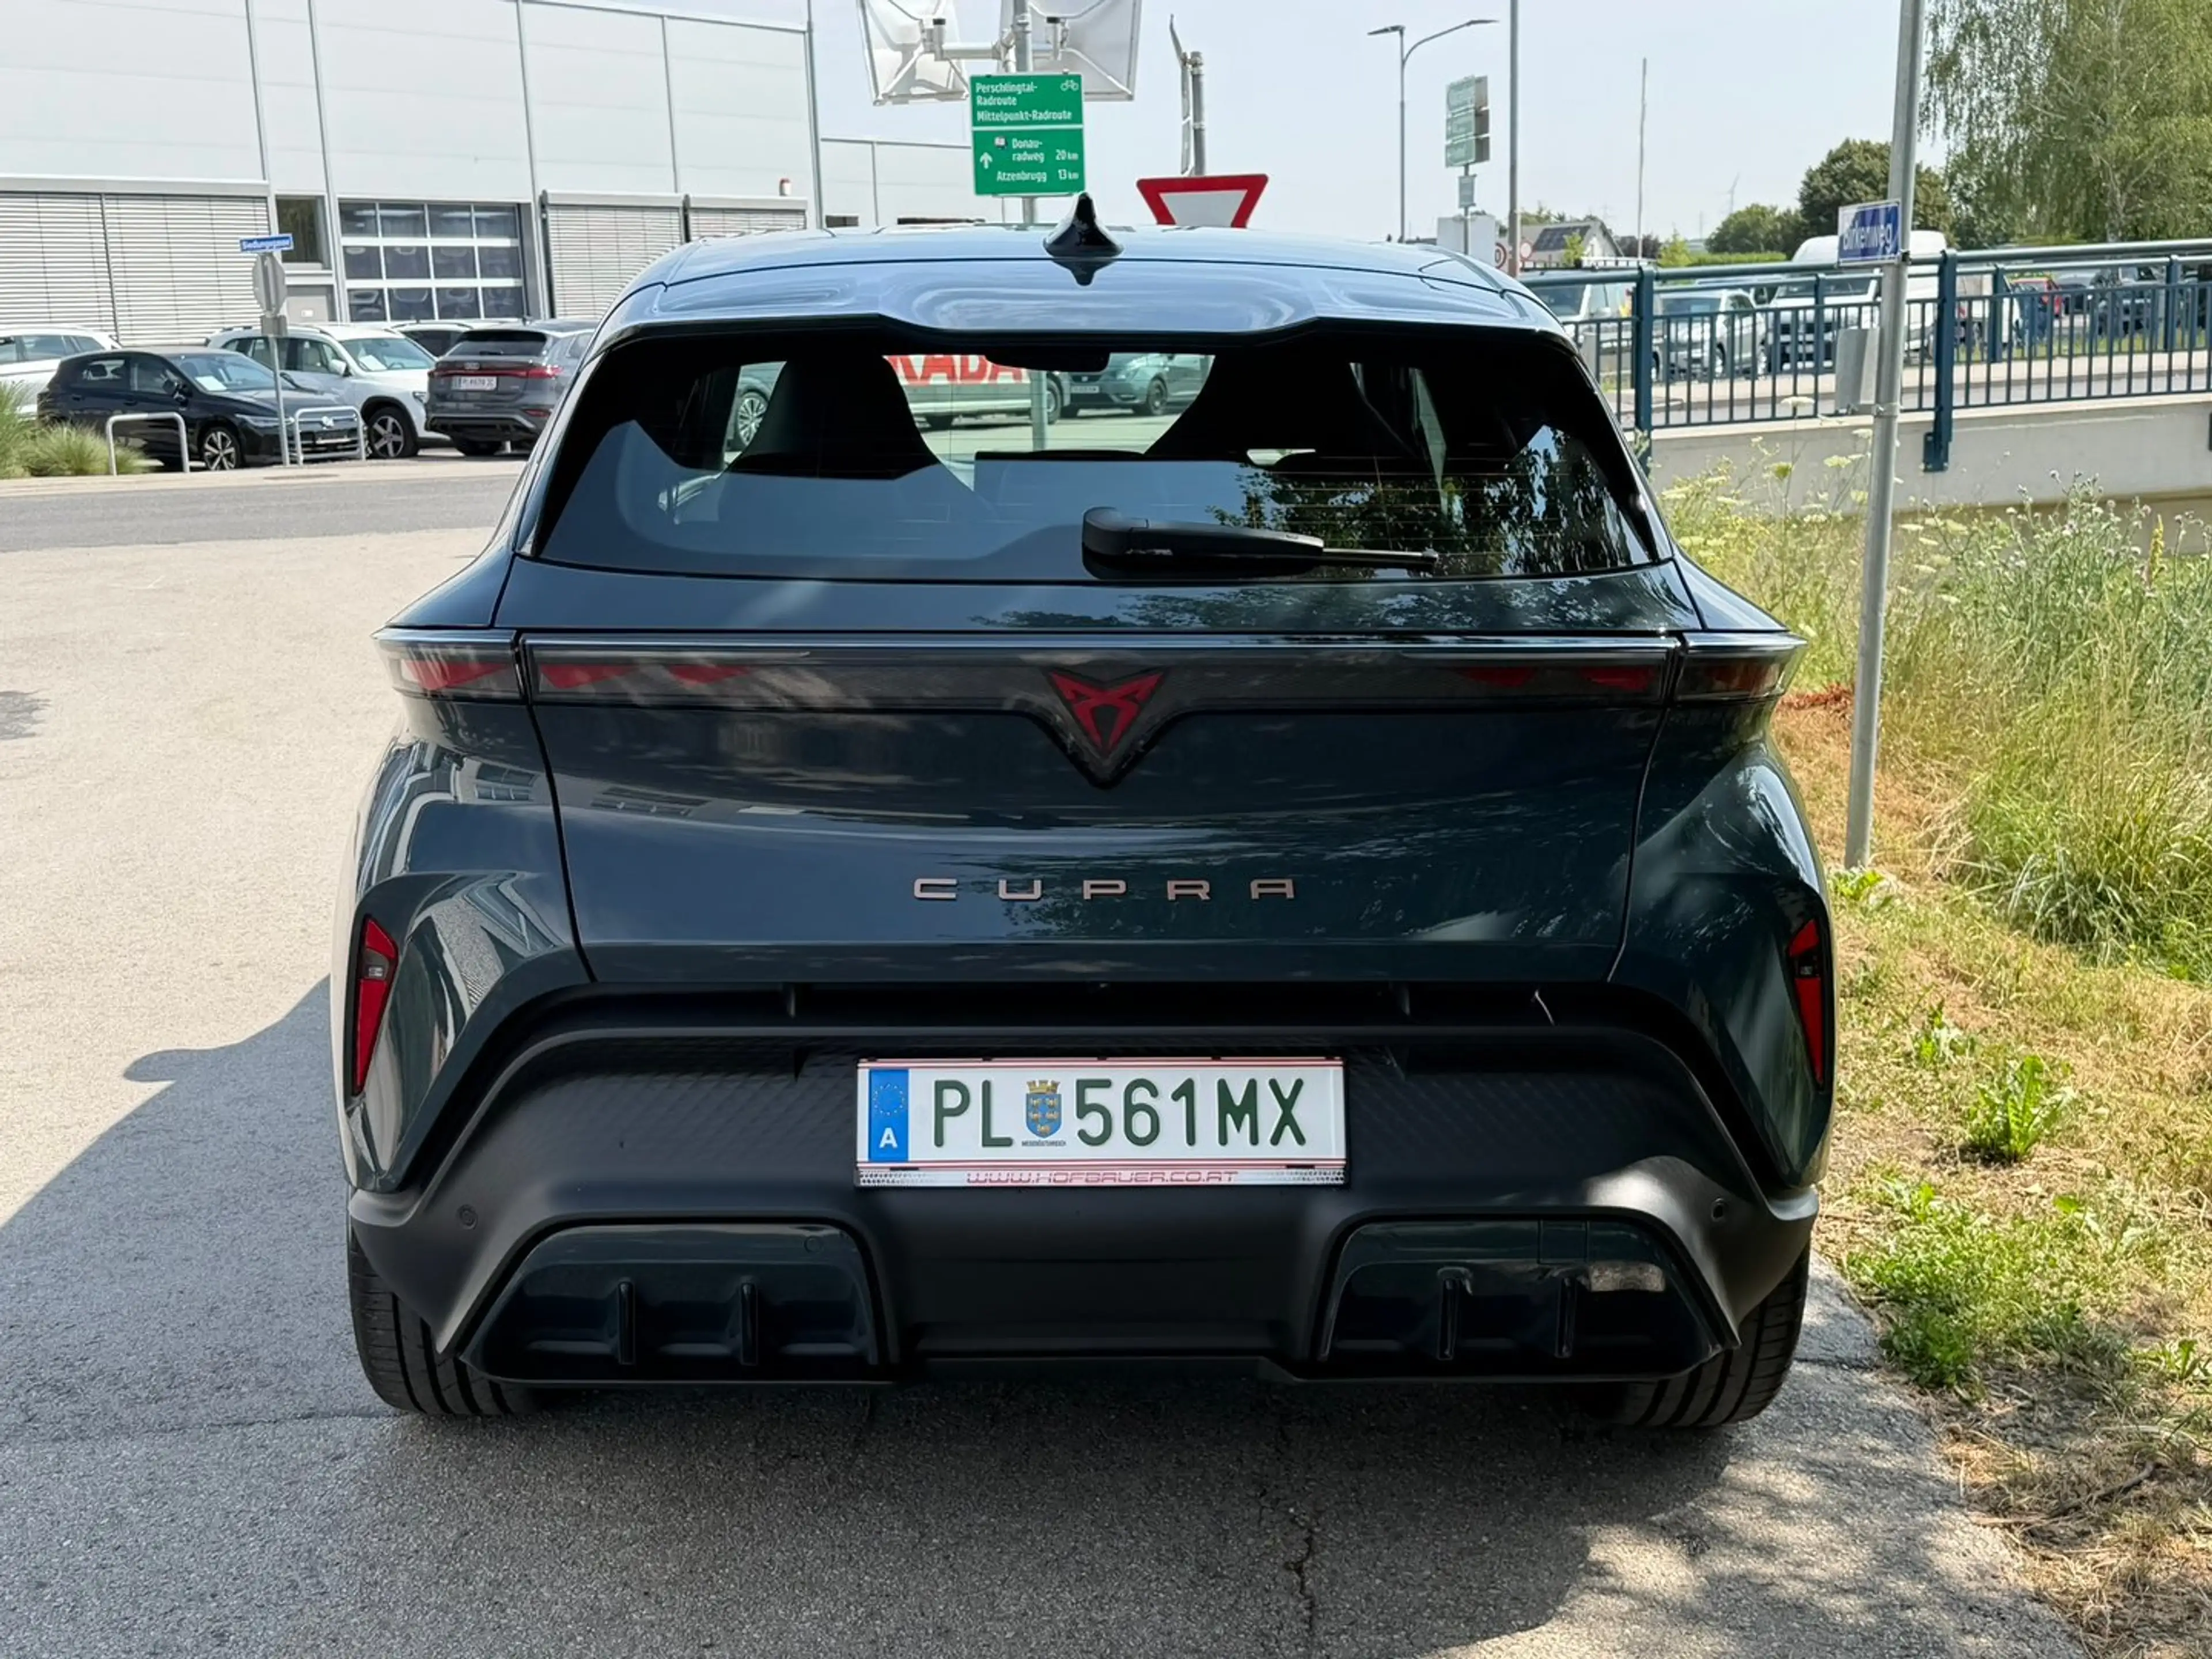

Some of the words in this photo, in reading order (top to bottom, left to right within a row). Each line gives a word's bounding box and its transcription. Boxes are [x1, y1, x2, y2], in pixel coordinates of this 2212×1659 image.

[975, 82, 1037, 94] Perschlingtal-
[976, 95, 1017, 106] Radroute
[976, 110, 1072, 123] Mittelpunkt-Radroute
[1012, 138, 1043, 149] Donau-
[1012, 151, 1044, 163] radweg
[1056, 150, 1066, 160] 20
[1067, 152, 1078, 160] km
[997, 171, 1047, 182] Atzenbrugg
[1058, 169, 1067, 180] 13
[914, 878, 1294, 900] CUPRA
[880, 1128, 897, 1148] A
[934, 1080, 1013, 1147] PL
[967, 1171, 1238, 1184] WWW.HOFBAUER.CO.AT
